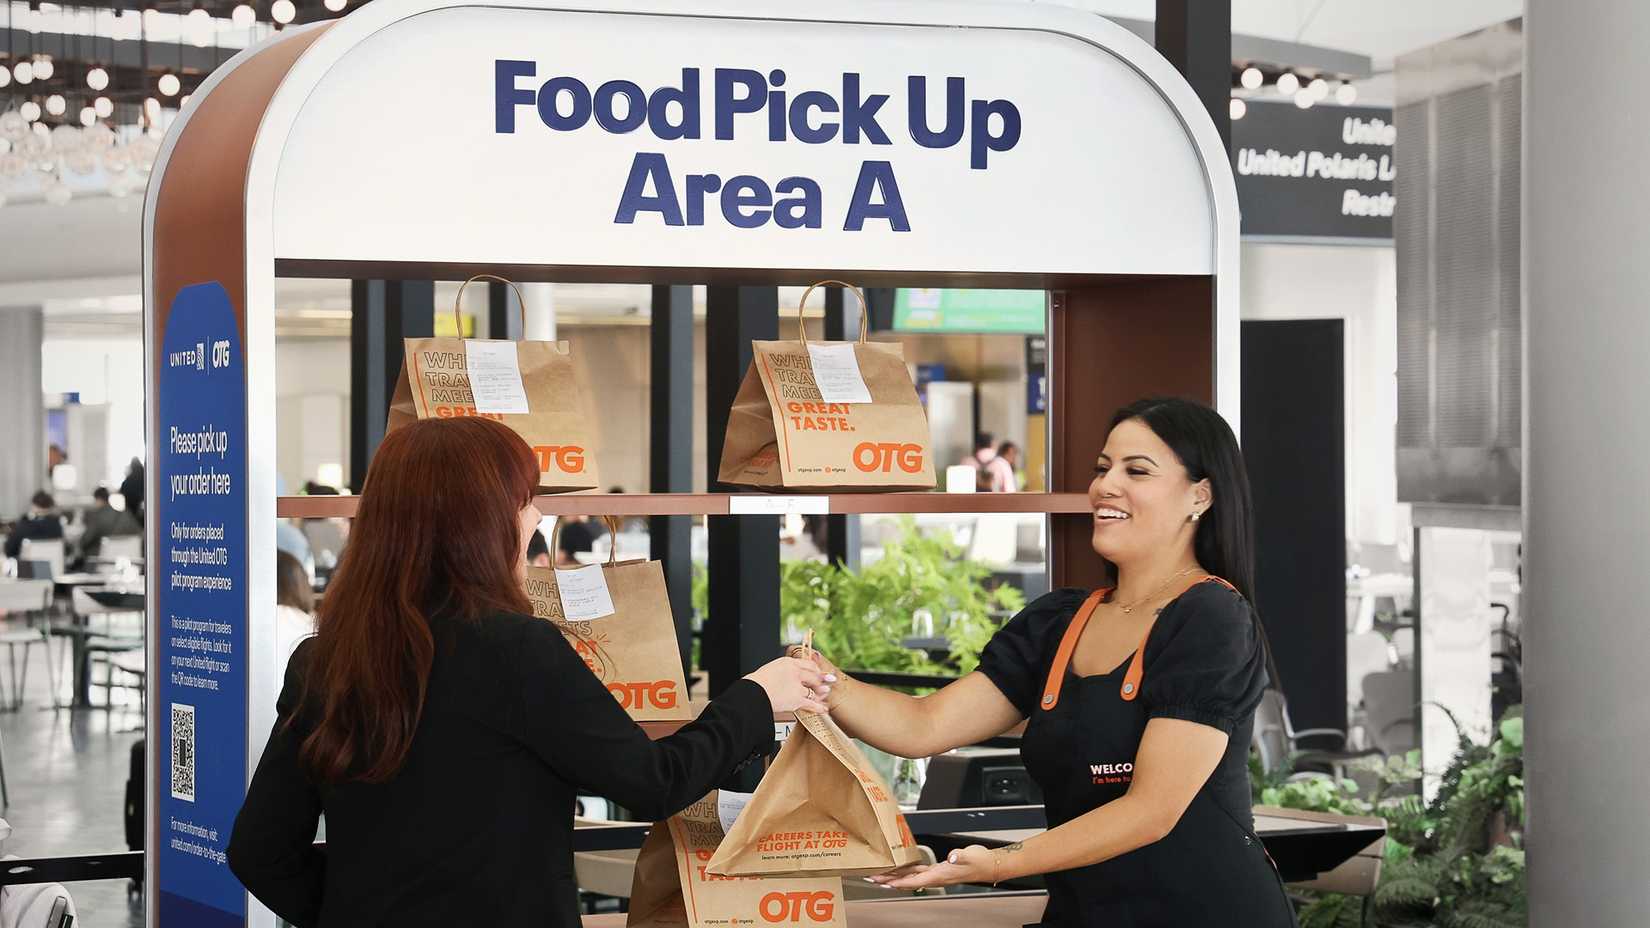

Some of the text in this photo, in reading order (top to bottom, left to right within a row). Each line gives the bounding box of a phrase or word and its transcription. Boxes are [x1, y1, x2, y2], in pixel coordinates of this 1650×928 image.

[495, 59, 1022, 170] Food Pick Up
[1238, 148, 1306, 176] United
[1306, 151, 1377, 180] Polaris
[613, 151, 911, 232] Area A
[170, 350, 196, 367] UNITED
[212, 340, 230, 368] OTG
[425, 372, 470, 388] TRA
[775, 368, 816, 386] TRA
[787, 402, 850, 414] GREAT
[791, 416, 856, 432] TASTE.
[171, 423, 228, 461] Please pick up
[852, 442, 924, 474] OTG
[171, 466, 231, 502] your order here
[171, 521, 182, 543] Only
[190, 522, 206, 540] orders
[206, 523, 224, 544] placed
[171, 546, 228, 568] through the United OTG
[171, 570, 182, 591] pilot
[182, 574, 203, 592] program
[1090, 762, 1133, 775] WELCO
[757, 839, 848, 852] FLIGHT AT OTG
[759, 831, 849, 843] CAREERS TAKE
[759, 890, 834, 923] OTG
